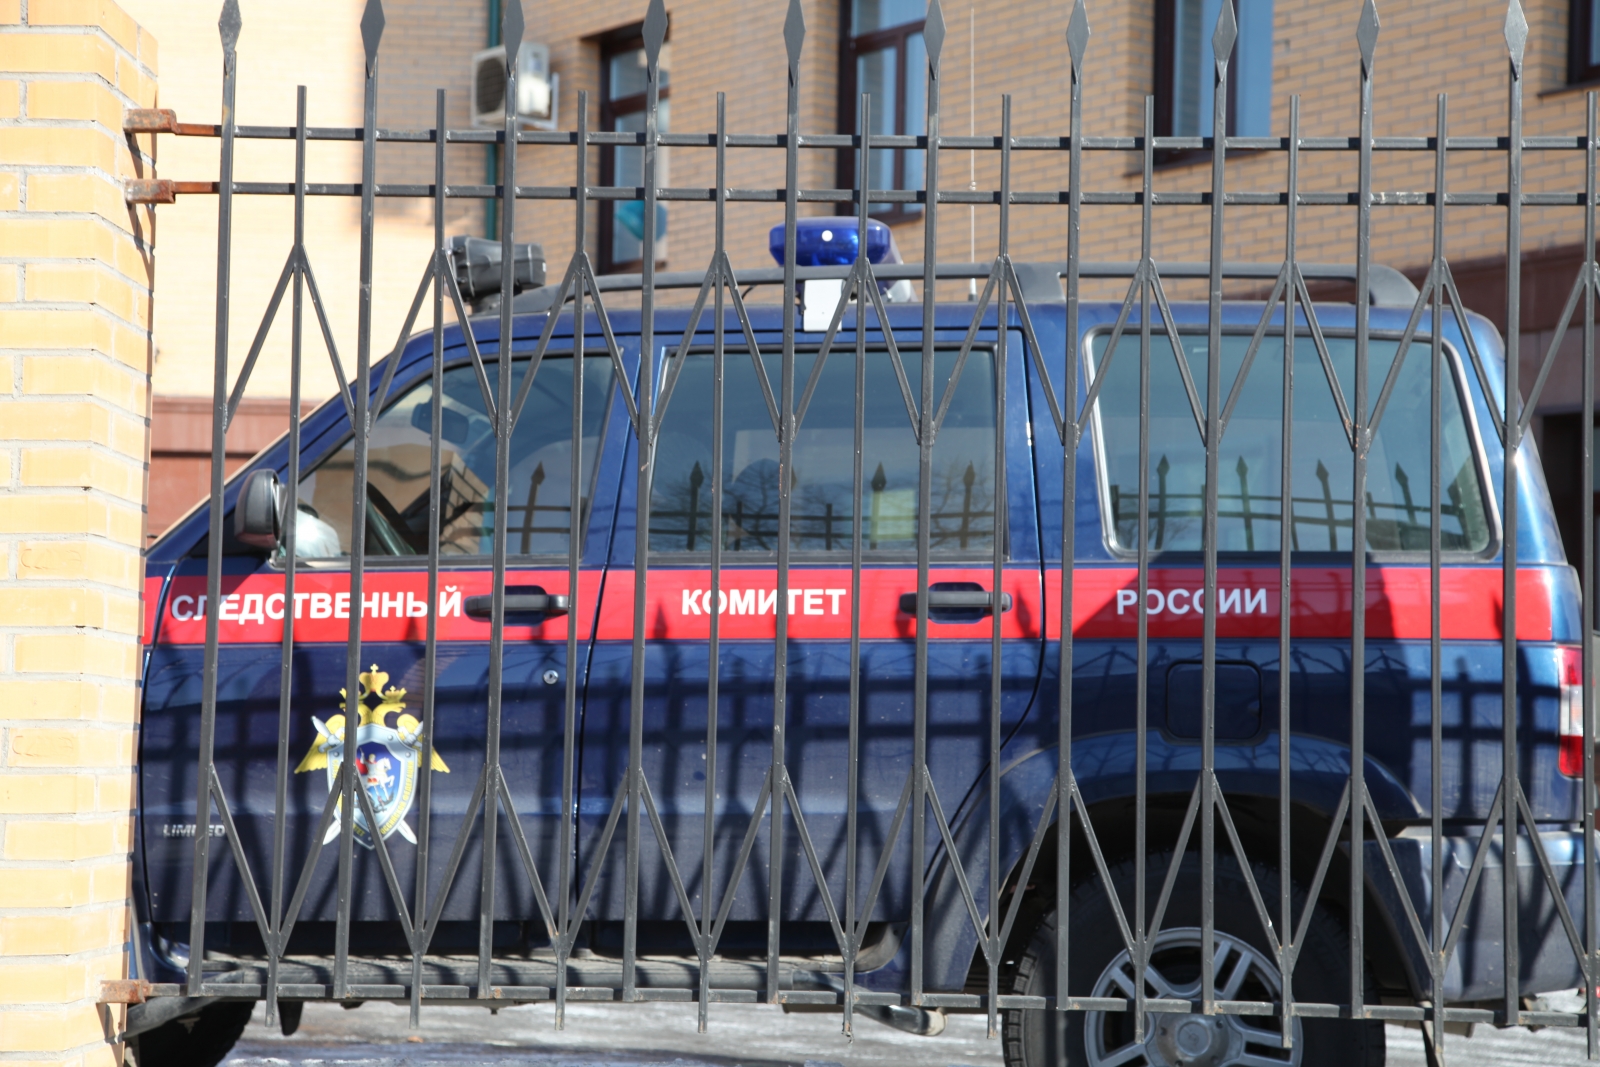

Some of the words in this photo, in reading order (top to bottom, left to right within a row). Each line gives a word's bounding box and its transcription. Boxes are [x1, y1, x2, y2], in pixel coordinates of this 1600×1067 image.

[681, 588, 847, 615] КОМИТЕТ
[1116, 588, 1268, 615] РОССИИ
[163, 824, 226, 838] LIMIED
